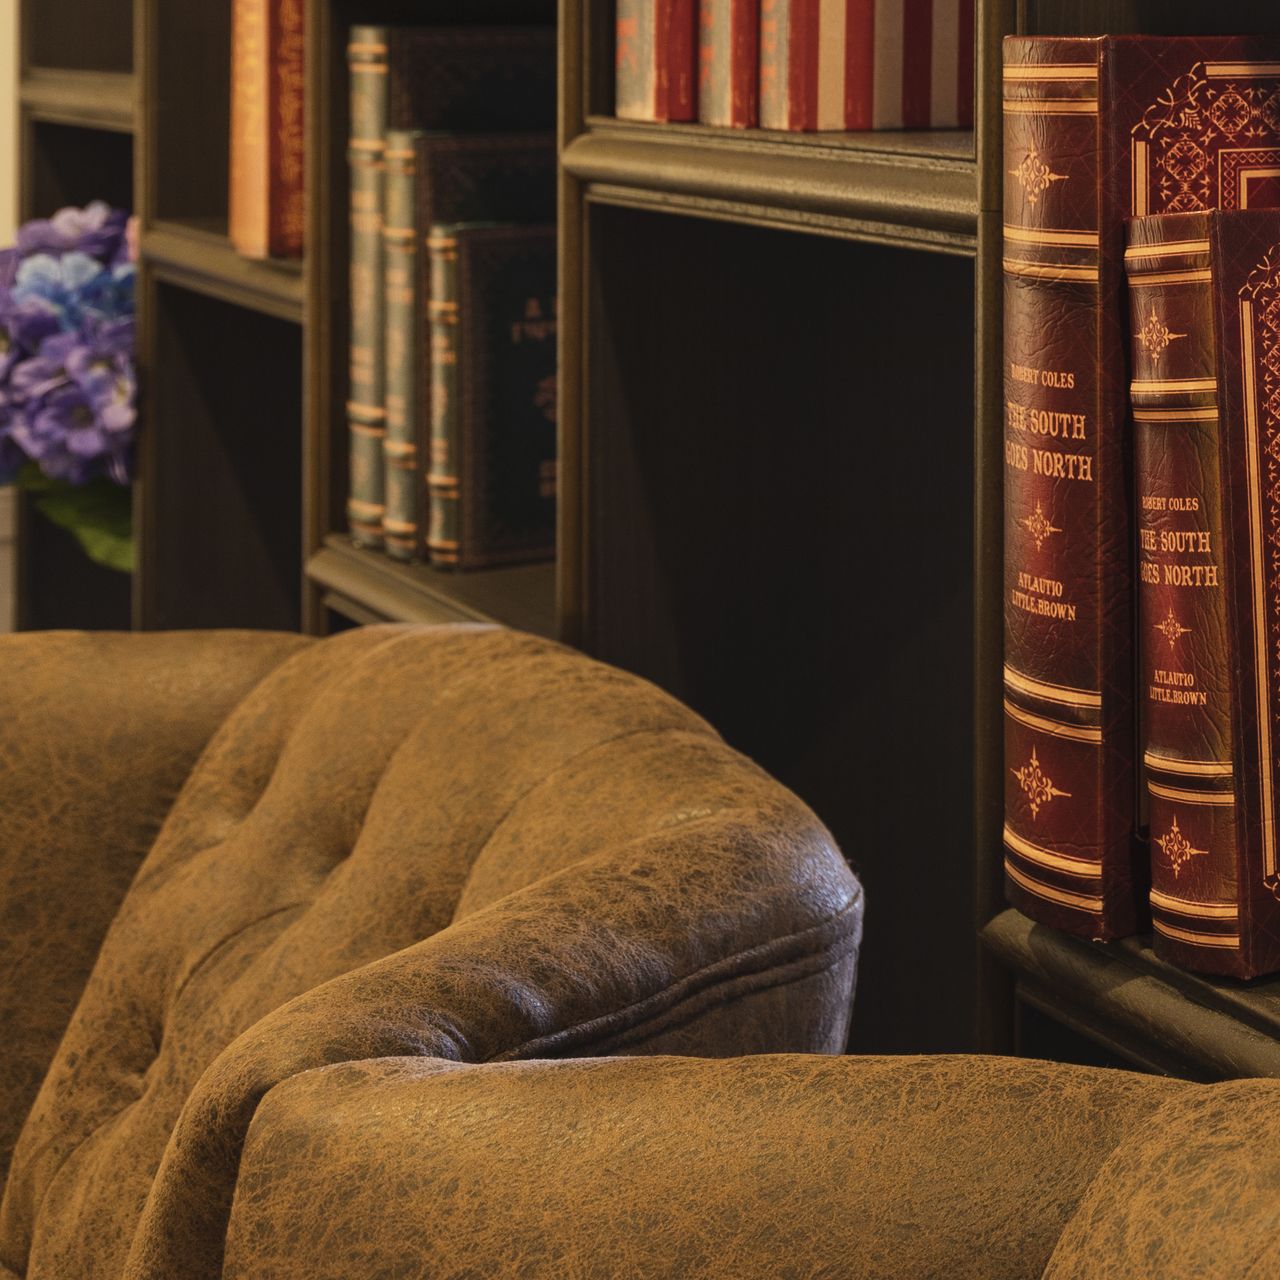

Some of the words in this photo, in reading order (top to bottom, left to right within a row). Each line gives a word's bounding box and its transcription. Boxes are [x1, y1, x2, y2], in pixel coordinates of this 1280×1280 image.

[1041, 371, 1075, 389] COLES
[1030, 408, 1086, 440] SOUTH
[1033, 449, 1093, 481] NORTH
[1168, 498, 1199, 511] COLES
[1161, 531, 1211, 552] SOUTH
[1164, 564, 1218, 586] NORTH
